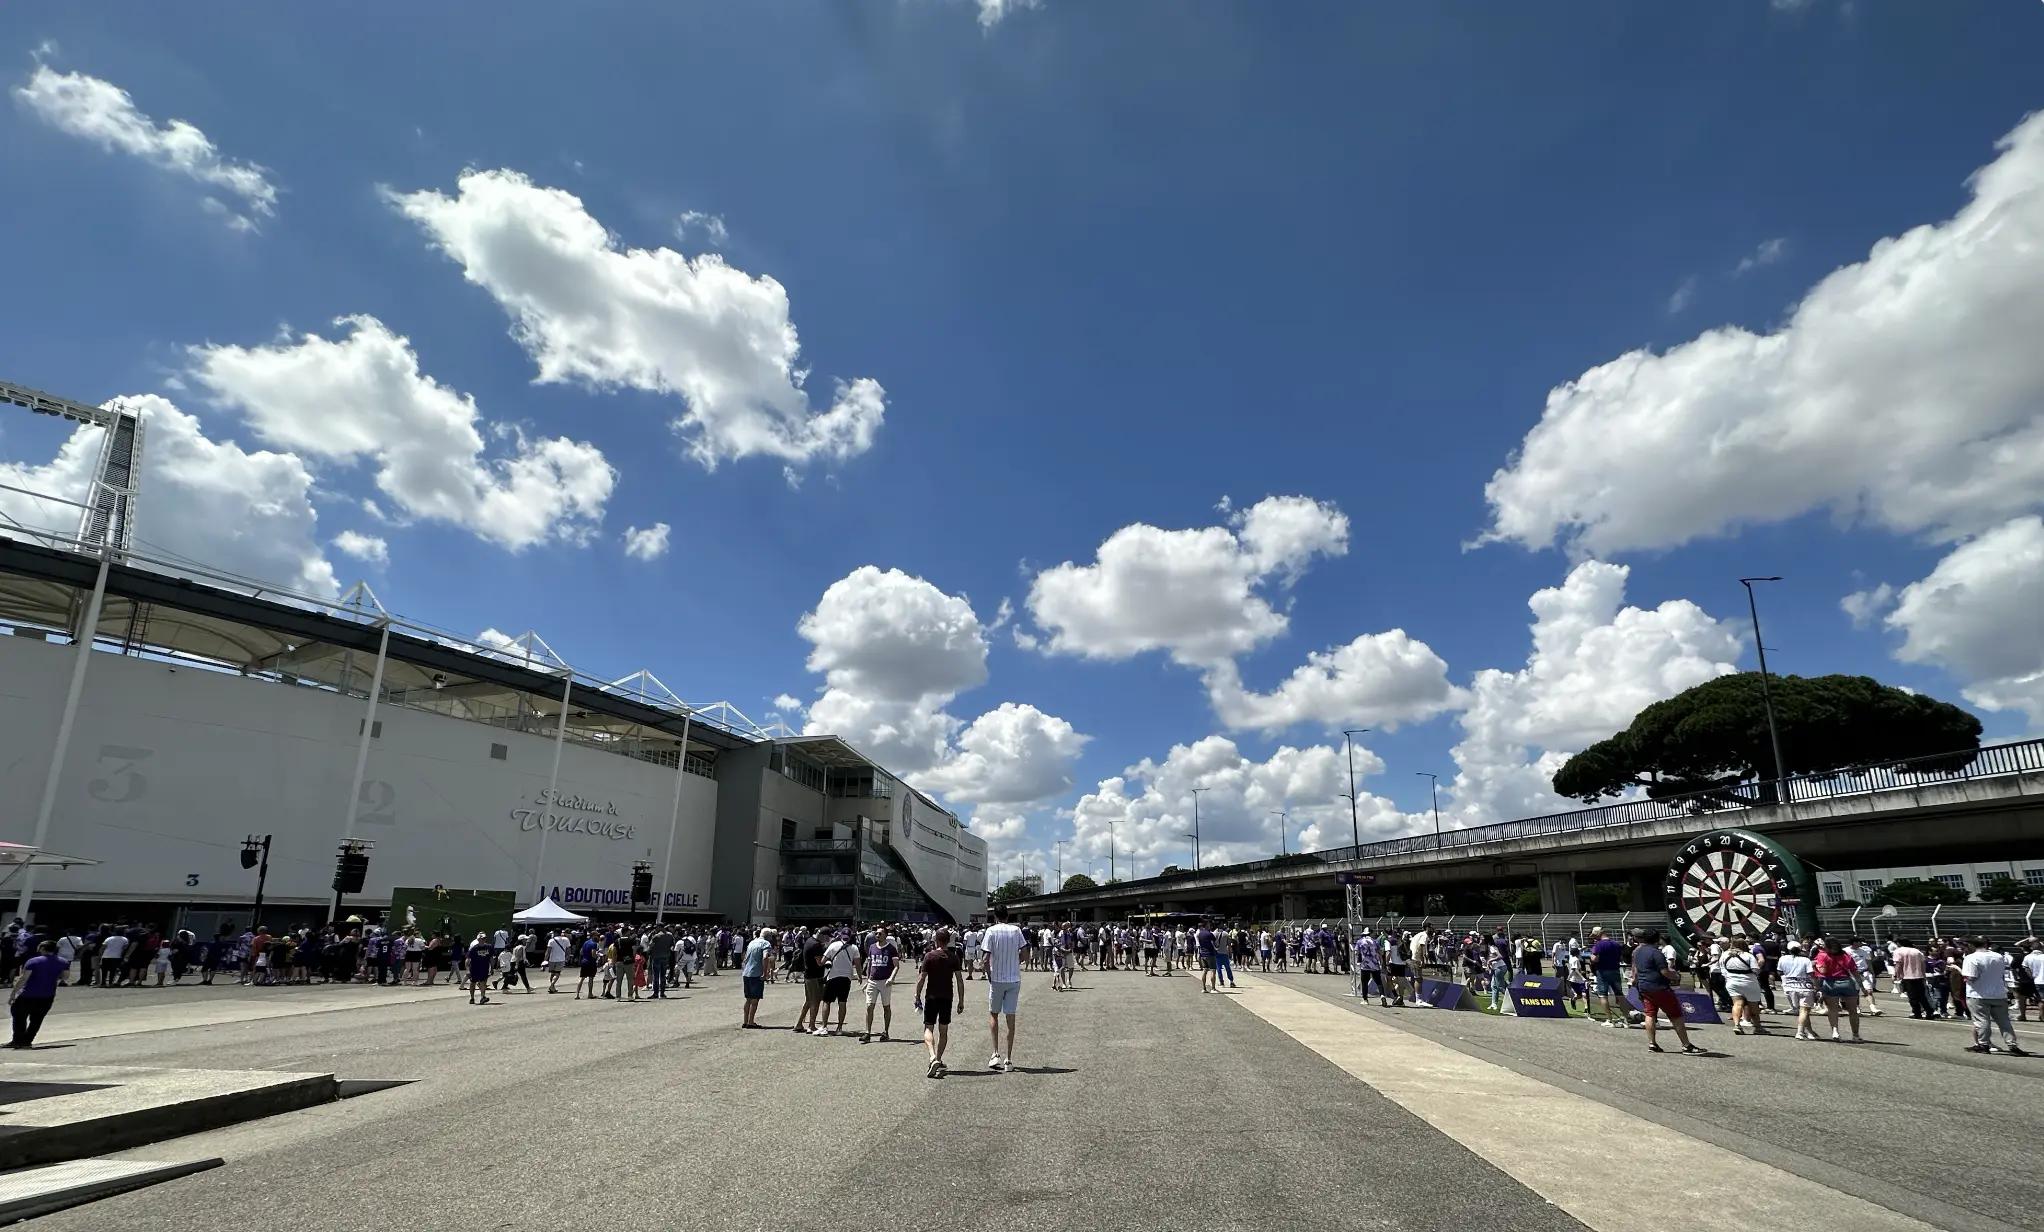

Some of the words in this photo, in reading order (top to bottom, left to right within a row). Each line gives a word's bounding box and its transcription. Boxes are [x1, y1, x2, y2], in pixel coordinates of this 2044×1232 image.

[88, 745, 154, 802] 3
[355, 779, 396, 826] 2
[1704, 839, 1711, 847] 5
[1719, 836, 1731, 845] 20
[1739, 840, 1745, 848] 1
[1687, 845, 1699, 855] 12
[1754, 848, 1764, 859] 18
[1676, 856, 1685, 864] 9
[1669, 868, 1679, 878] 14
[186, 874, 199, 886] 3
[1776, 878, 1788, 889] 13
[1667, 885, 1676, 894] 11
[565, 887, 630, 906] BOUTIQUE
[756, 889, 770, 911] 01
[1675, 917, 1685, 928] 16
[382, 945, 388, 953] 9
[1520, 998, 1540, 1006] FANS
[1540, 998, 1554, 1006] DAY
